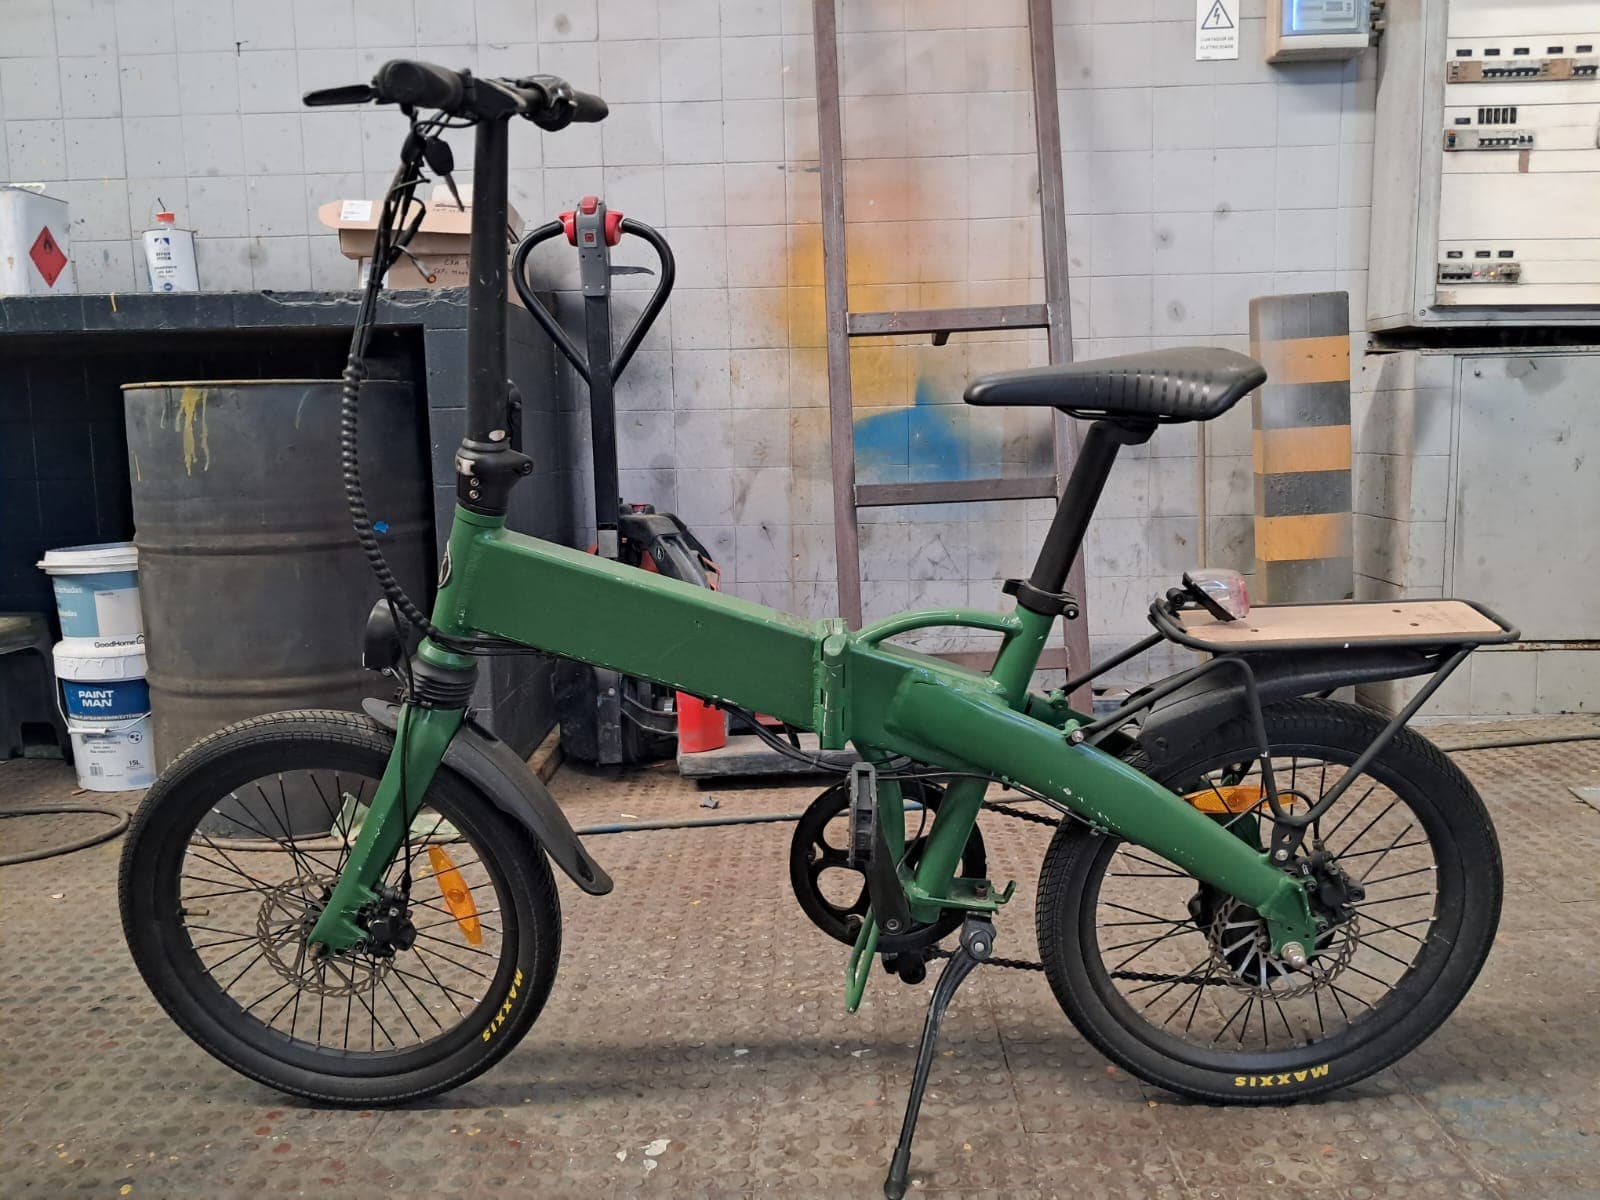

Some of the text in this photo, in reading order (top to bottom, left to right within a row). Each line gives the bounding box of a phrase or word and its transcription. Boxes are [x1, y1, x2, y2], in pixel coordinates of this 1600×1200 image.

[78, 690, 114, 698] PAINT
[82, 699, 112, 707] MAN
[482, 967, 523, 1042] MAXXIS
[1234, 1063, 1329, 1087] MAXXIS
